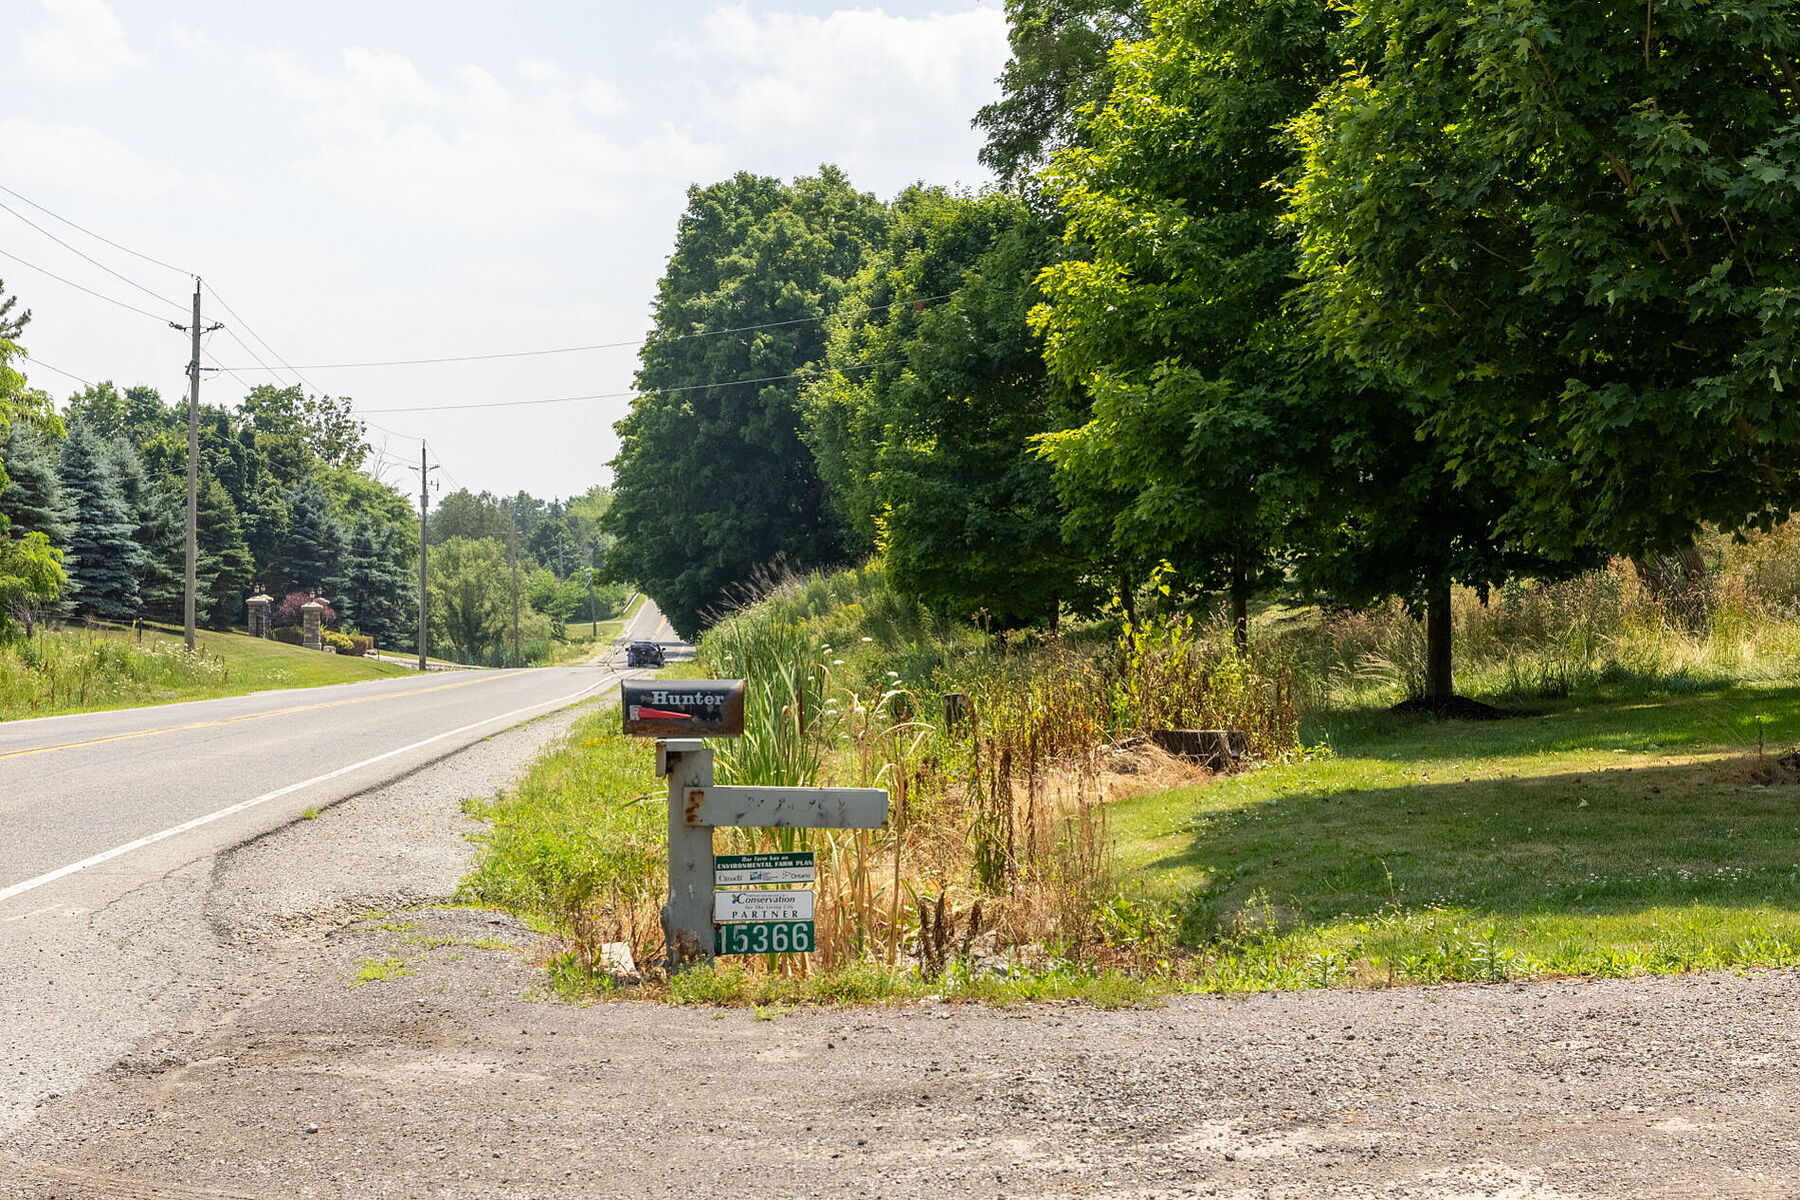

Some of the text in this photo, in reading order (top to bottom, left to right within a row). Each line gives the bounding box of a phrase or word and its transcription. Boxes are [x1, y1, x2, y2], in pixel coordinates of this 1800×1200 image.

[651, 691, 724, 705] Hunter
[717, 861, 772, 869] ENVIRONMENTAL
[737, 893, 795, 904] Conservation
[732, 910, 799, 919] PARTNER
[719, 923, 809, 954] 15366
